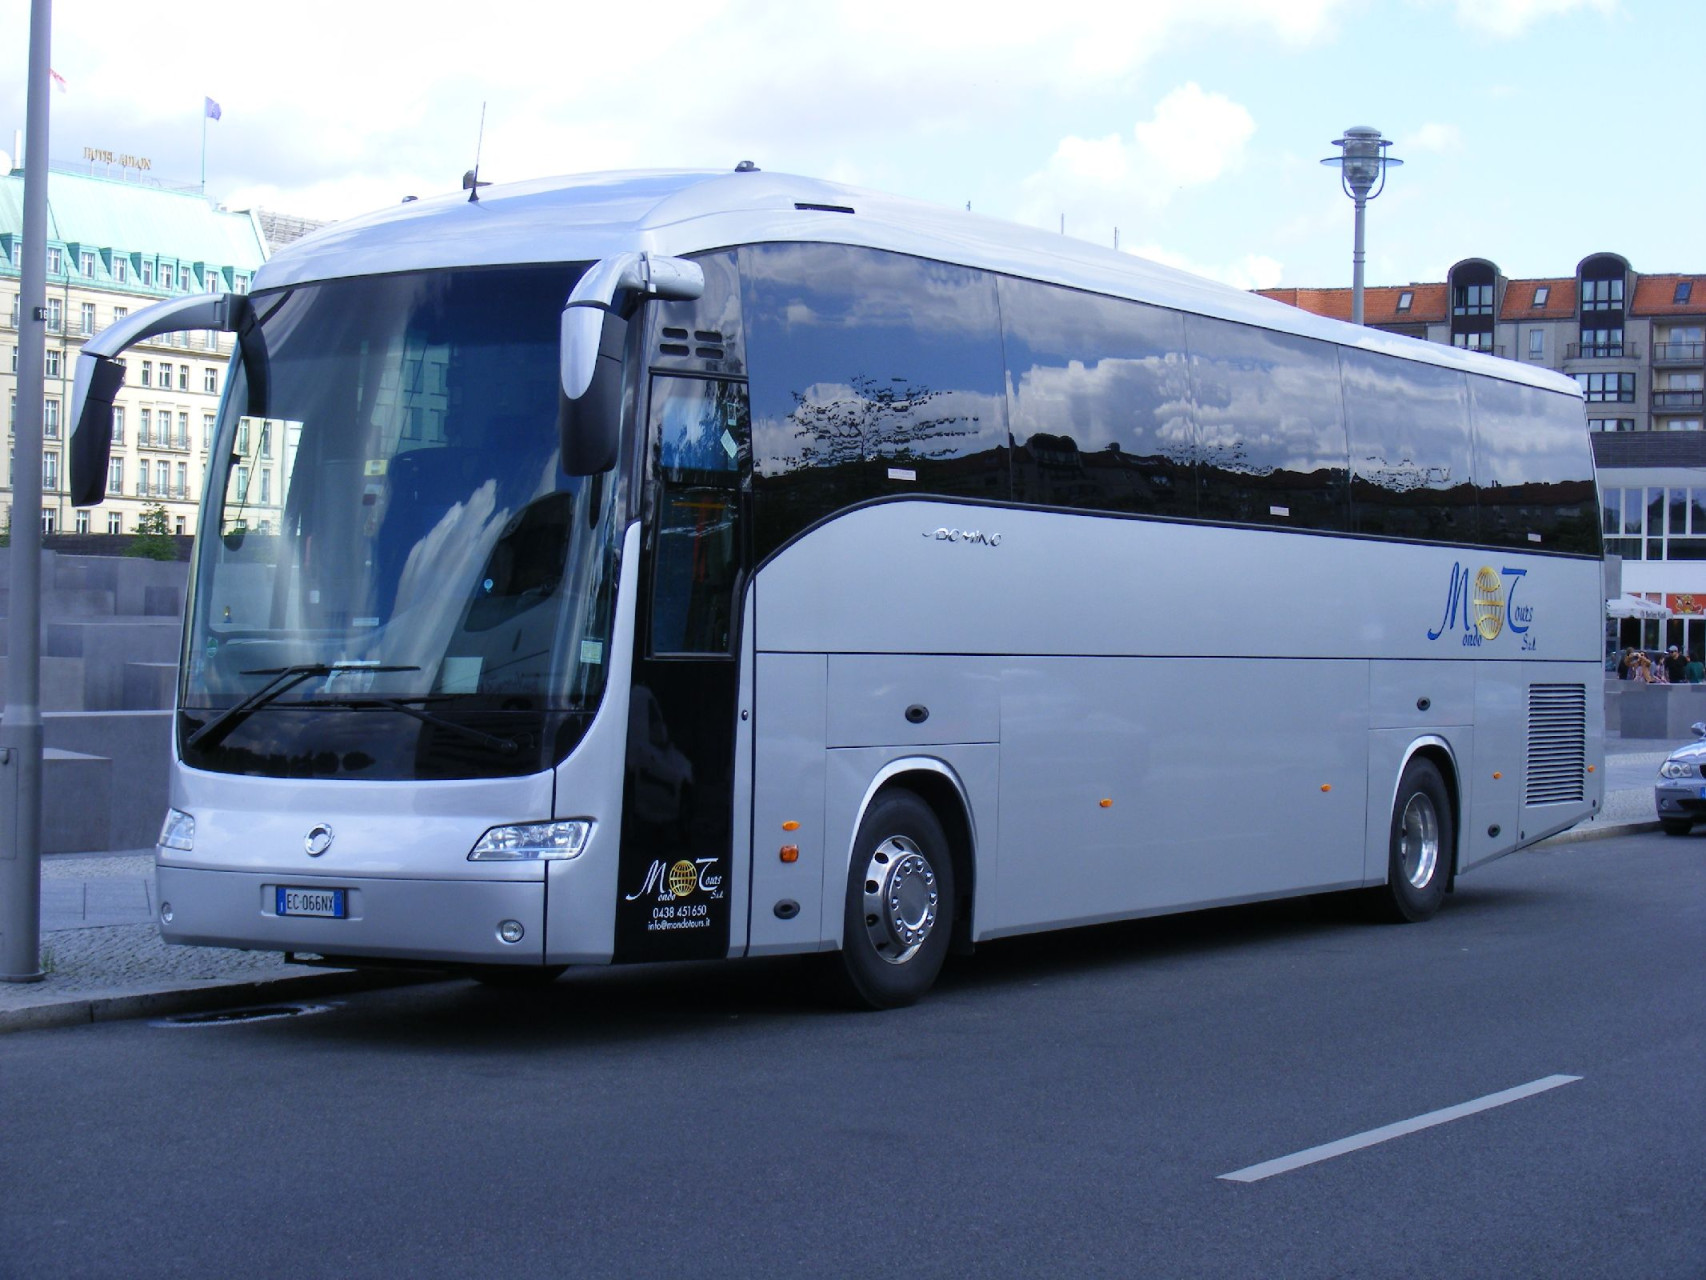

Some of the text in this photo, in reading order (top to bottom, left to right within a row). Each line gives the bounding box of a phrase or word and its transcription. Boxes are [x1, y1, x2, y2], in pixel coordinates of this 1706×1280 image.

[652, 904, 707, 919] 0438 451650
[648, 917, 710, 931] info@mondotours.it
